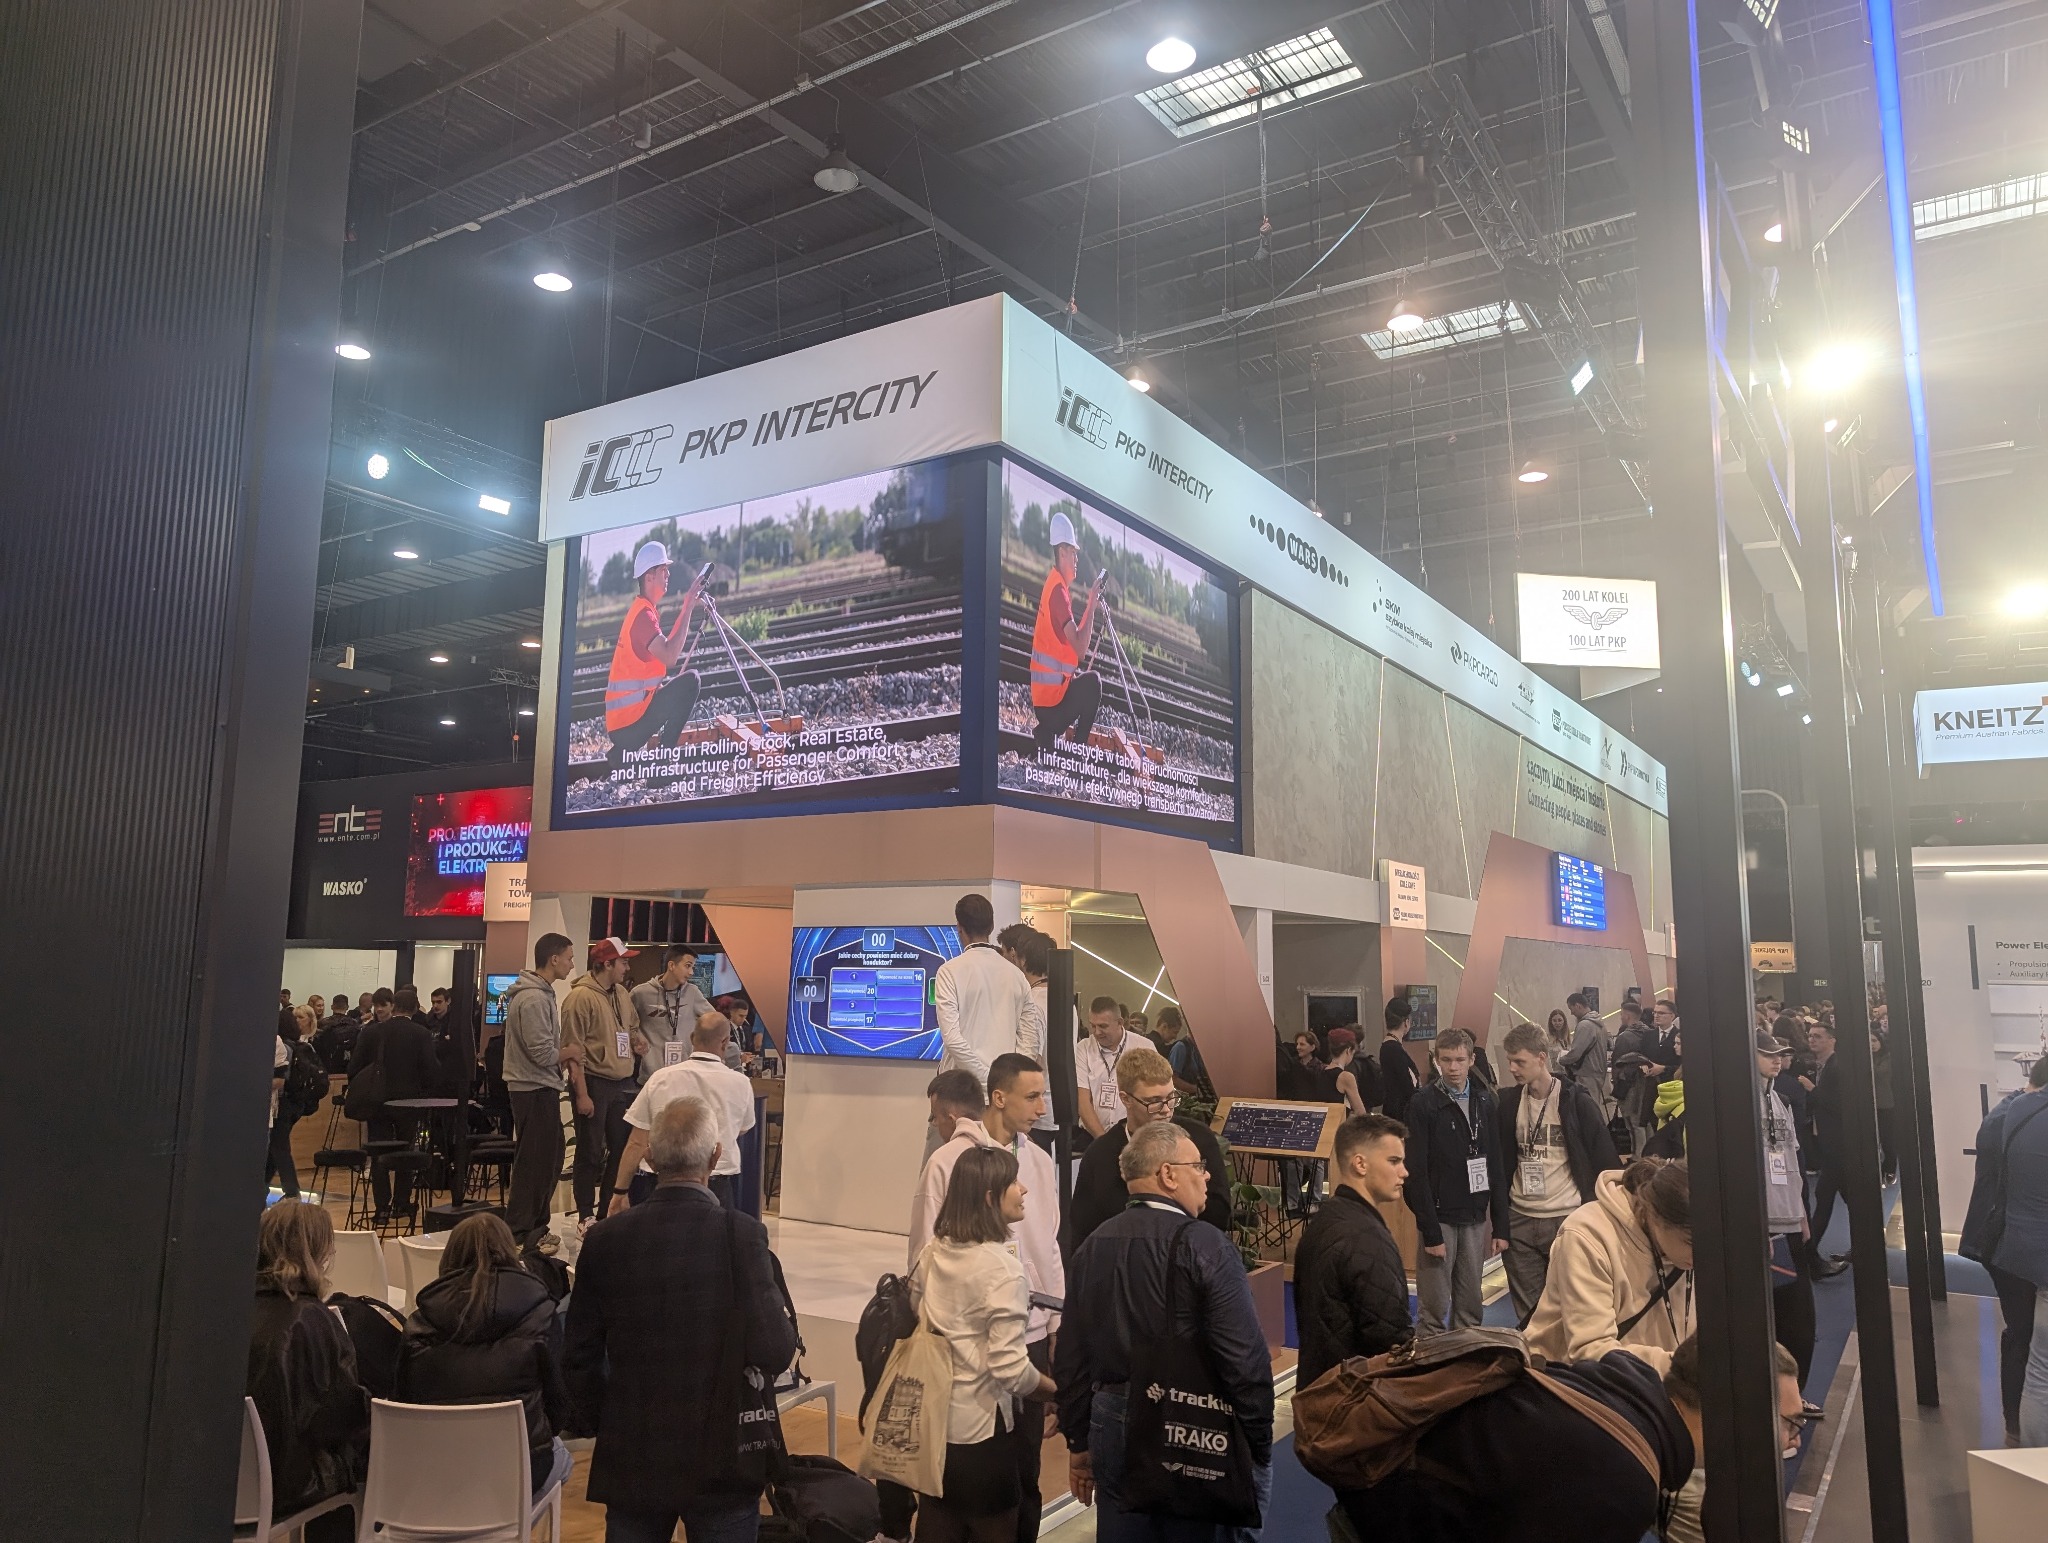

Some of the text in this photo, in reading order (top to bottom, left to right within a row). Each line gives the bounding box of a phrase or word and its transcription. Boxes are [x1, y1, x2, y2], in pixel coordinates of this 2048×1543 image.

[679, 418, 748, 464] PKP
[752, 370, 939, 447] INTERCITY
[1115, 430, 1146, 460] PKP
[1148, 451, 1213, 504] INTERCITY
[1290, 537, 1316, 569] WARS
[1385, 599, 1400, 616] SKM
[1562, 590, 1629, 604] 200 LAT KOLEI
[1568, 634, 1627, 648] 100 LAT PKP
[1934, 705, 2045, 732] KNEITZ
[622, 744, 680, 764] Investing
[684, 742, 697, 758] in
[701, 738, 748, 756] Rolling
[799, 731, 831, 748] Real
[835, 726, 887, 744] Estate,
[1936, 733, 1973, 741] Premium
[1976, 731, 2009, 739] Austrian
[1054, 734, 1104, 763] Inwestycje
[1105, 751, 1115, 764] w
[610, 742, 901, 781] and Infrastructure for Passenger Comfort
[1037, 747, 1041, 764] i
[1043, 748, 1109, 783] infrastrukturę
[1117, 768, 1131, 785] dla
[670, 777, 696, 793] and
[700, 771, 749, 792] Freight
[1025, 766, 1078, 790] pasażerów
[1080, 776, 1084, 792] i
[1085, 778, 1142, 806] efektywnego
[1528, 788, 1554, 819] Connecting
[317, 832, 380, 843] www.ente.com.pl
[428, 822, 532, 843] PROEKTOWANI
[444, 840, 523, 858] PRODUKCJA
[323, 880, 364, 896] WASKO
[872, 933, 886, 947] 00
[1996, 941, 2030, 949] Power
[903, 952, 920, 960] dobry
[804, 985, 817, 998] 00
[1164, 1424, 1228, 1452] TRAKO
